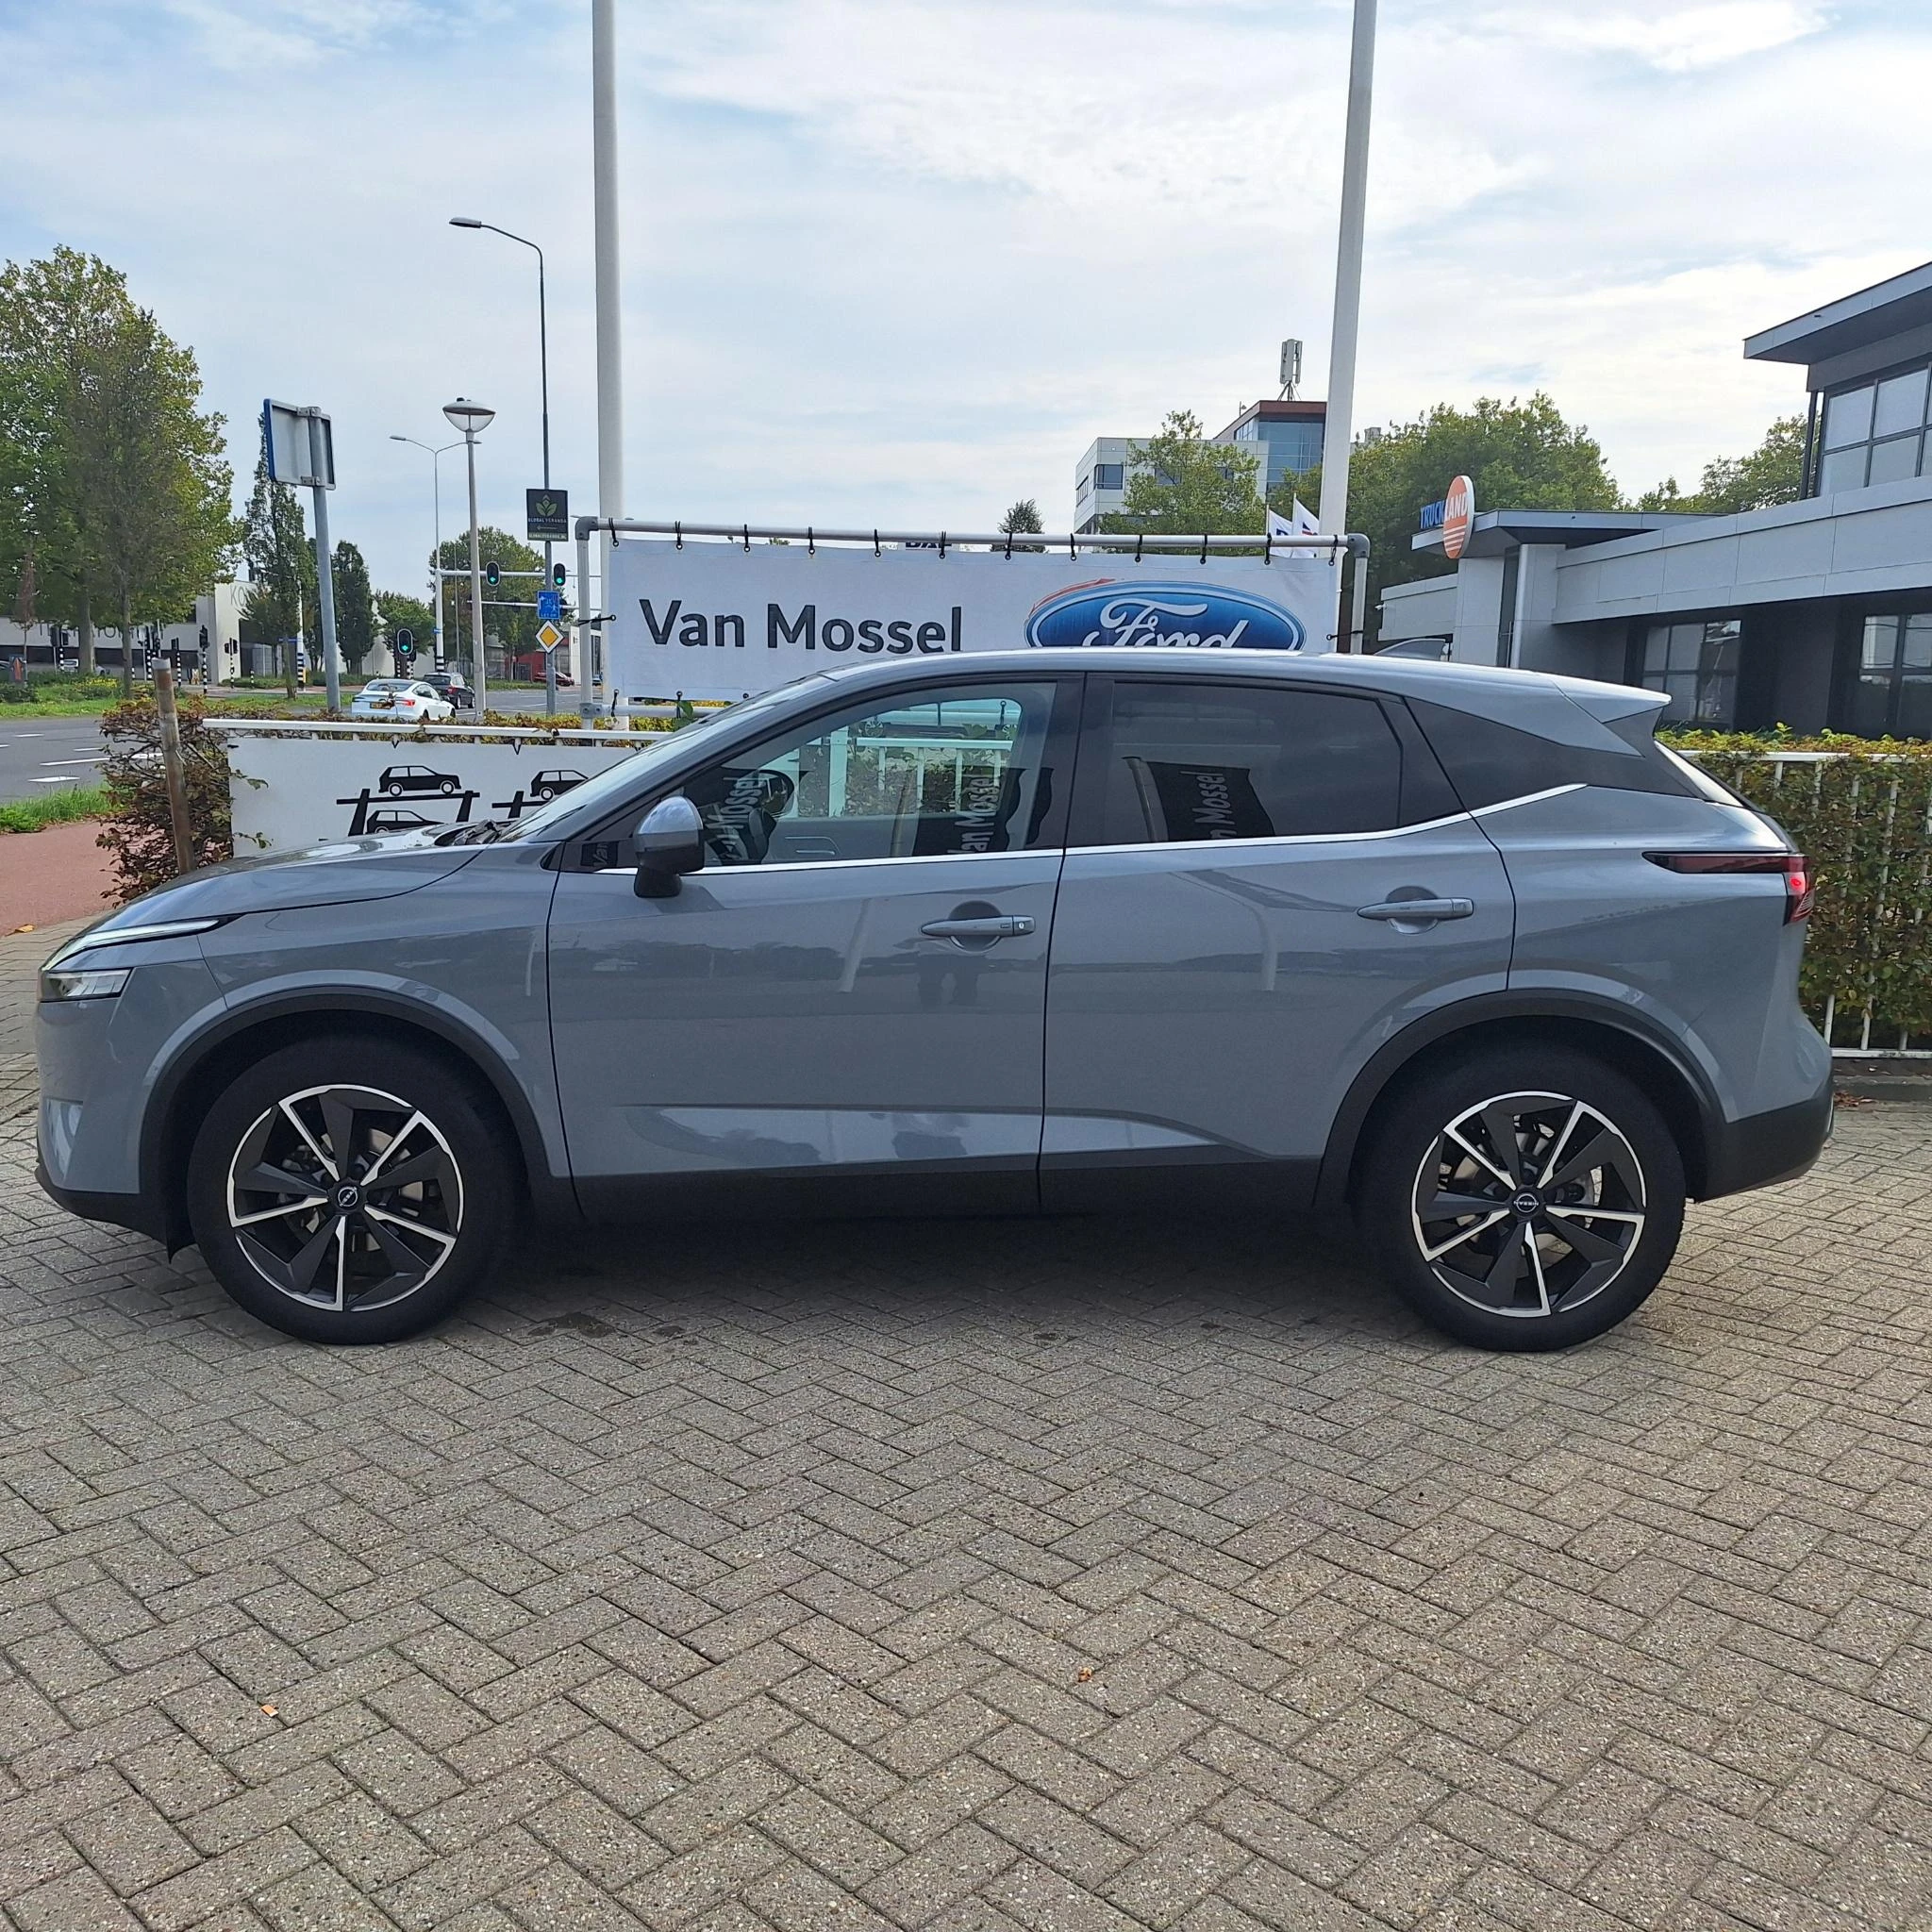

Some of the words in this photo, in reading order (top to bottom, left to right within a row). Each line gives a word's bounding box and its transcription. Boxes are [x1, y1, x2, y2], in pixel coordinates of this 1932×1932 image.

[639, 599, 744, 647] Van
[767, 603, 961, 655] Mossel
[1180, 770, 1235, 825] Mossel
